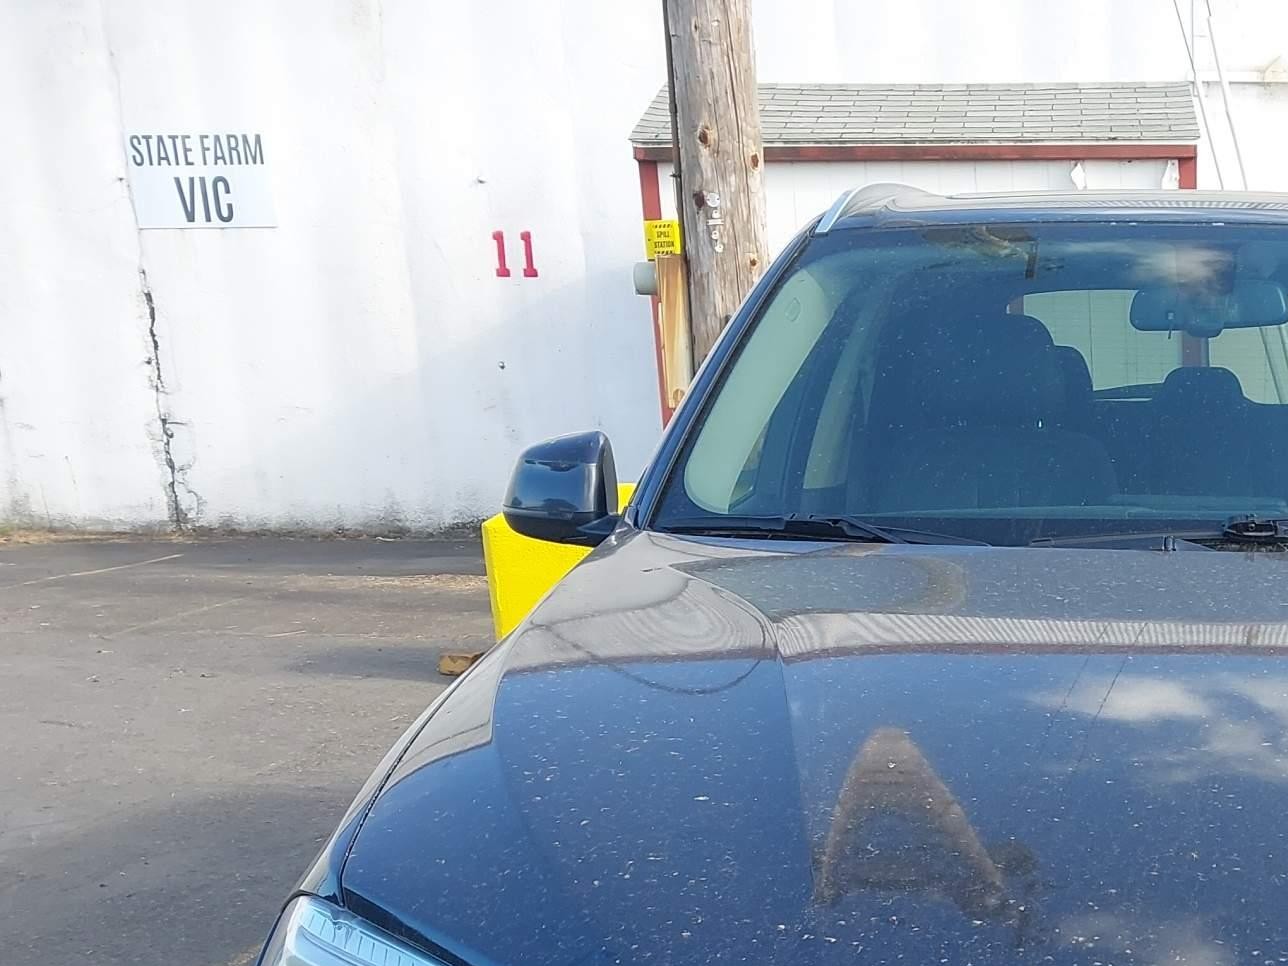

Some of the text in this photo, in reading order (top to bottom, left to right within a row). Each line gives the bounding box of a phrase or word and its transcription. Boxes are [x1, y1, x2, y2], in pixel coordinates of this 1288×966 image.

[130, 133, 264, 167] STATE FARM
[174, 175, 234, 223] VIC
[492, 230, 539, 278] 11
